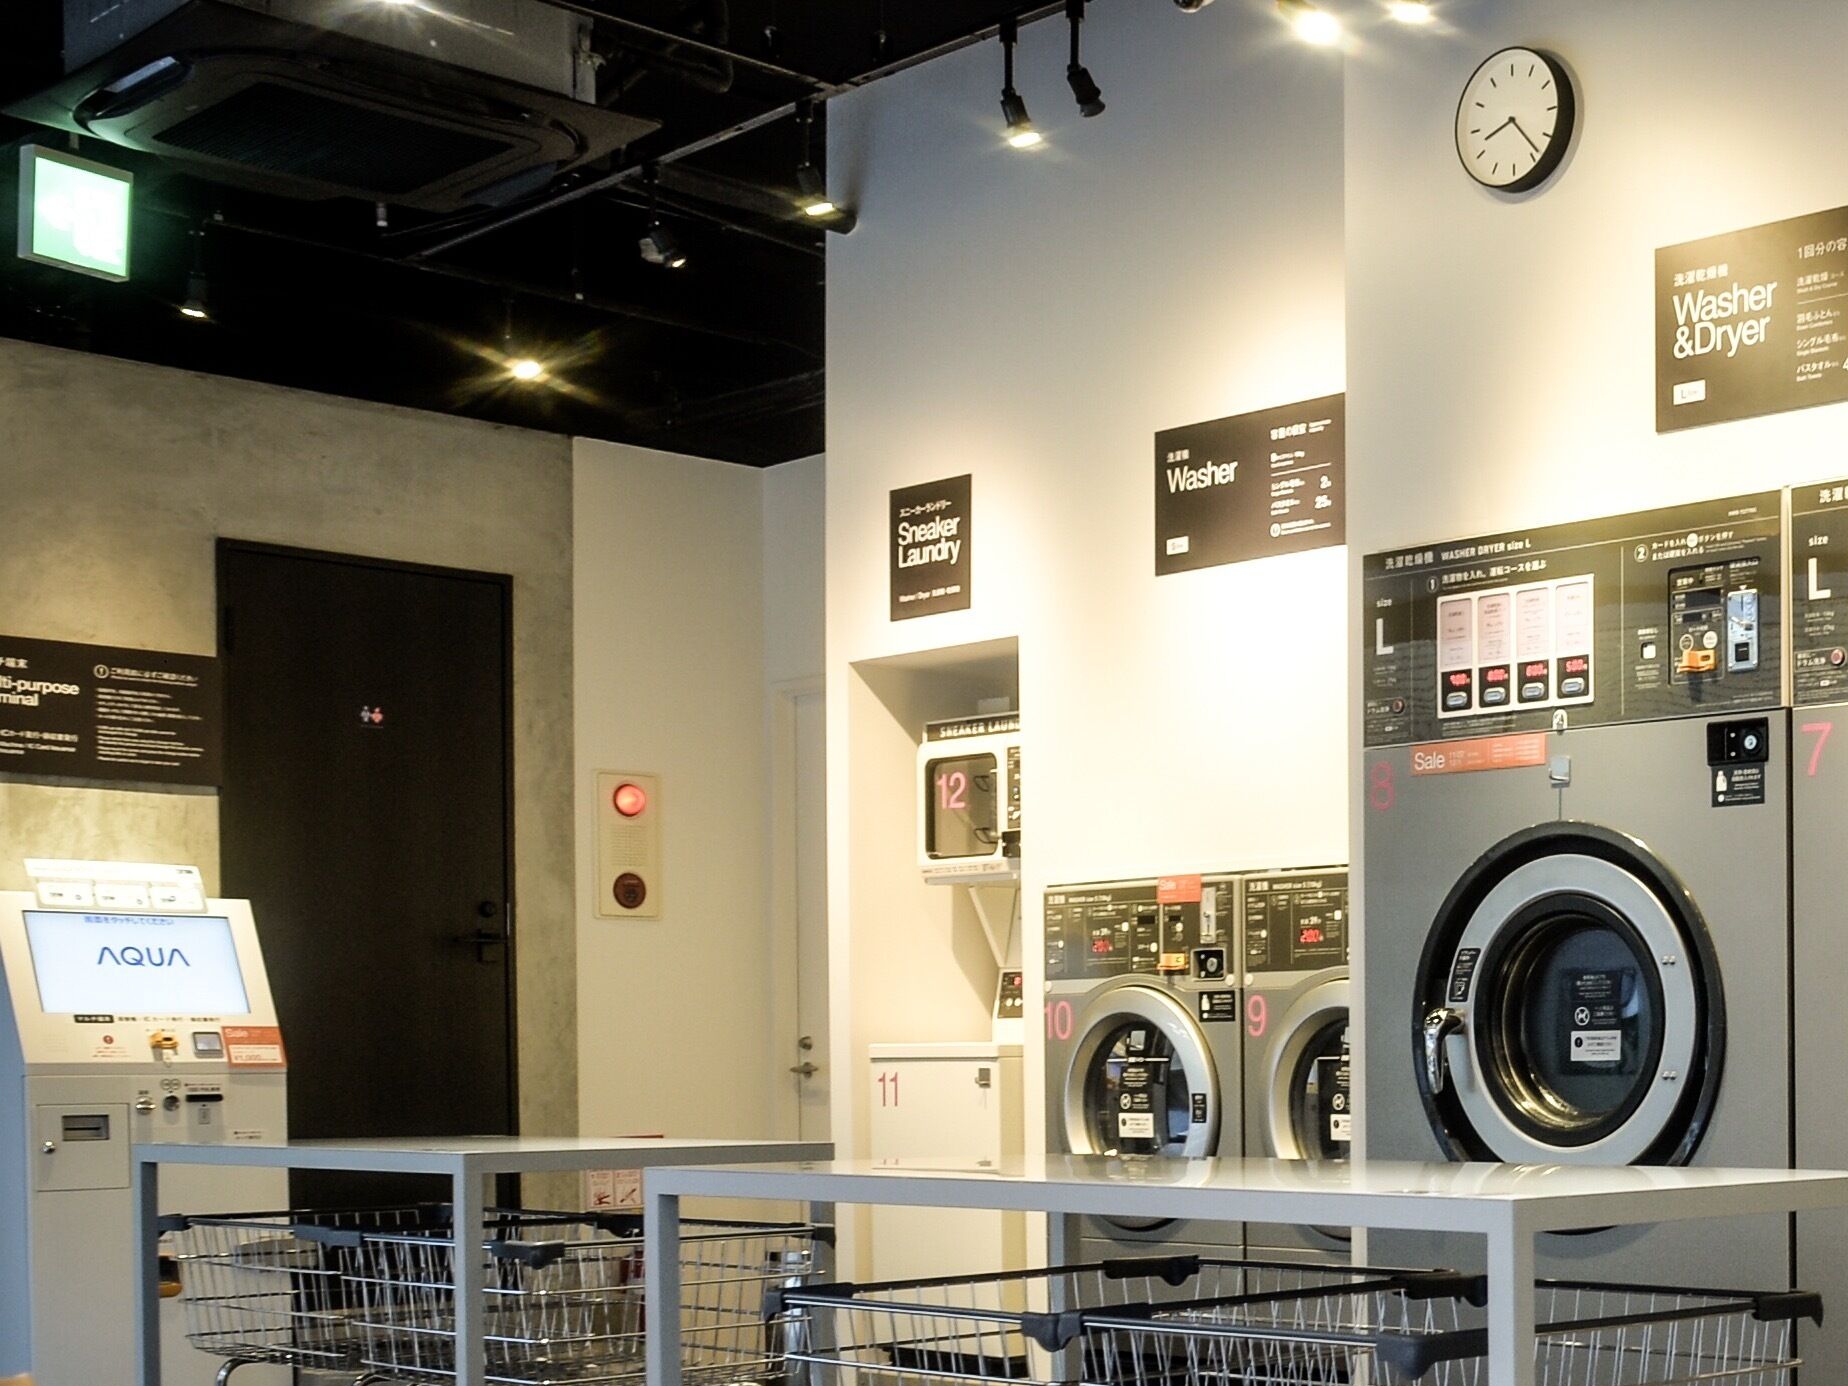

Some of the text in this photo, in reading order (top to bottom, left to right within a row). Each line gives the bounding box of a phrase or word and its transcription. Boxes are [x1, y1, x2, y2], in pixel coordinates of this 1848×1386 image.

[1673, 282, 1778, 326] Washer
[1673, 316, 1771, 359] &Dryer
[1167, 461, 1238, 493] Washer
[898, 515, 961, 546] Sneaker
[1808, 534, 1829, 546] size
[898, 537, 961, 568] Laundry
[1441, 546, 1476, 561] WASHER
[1808, 557, 1831, 600] L
[1376, 618, 1394, 655] L
[940, 722, 985, 738] SNEAKER
[1414, 752, 1446, 771] Sale
[1801, 722, 1833, 777] 7
[936, 771, 967, 810] 12
[1371, 761, 1396, 811] 8
[97, 946, 190, 967] AQUA
[1044, 1000, 1074, 1041] 10
[1247, 994, 1267, 1038] 9
[878, 1071, 899, 1107] 11
